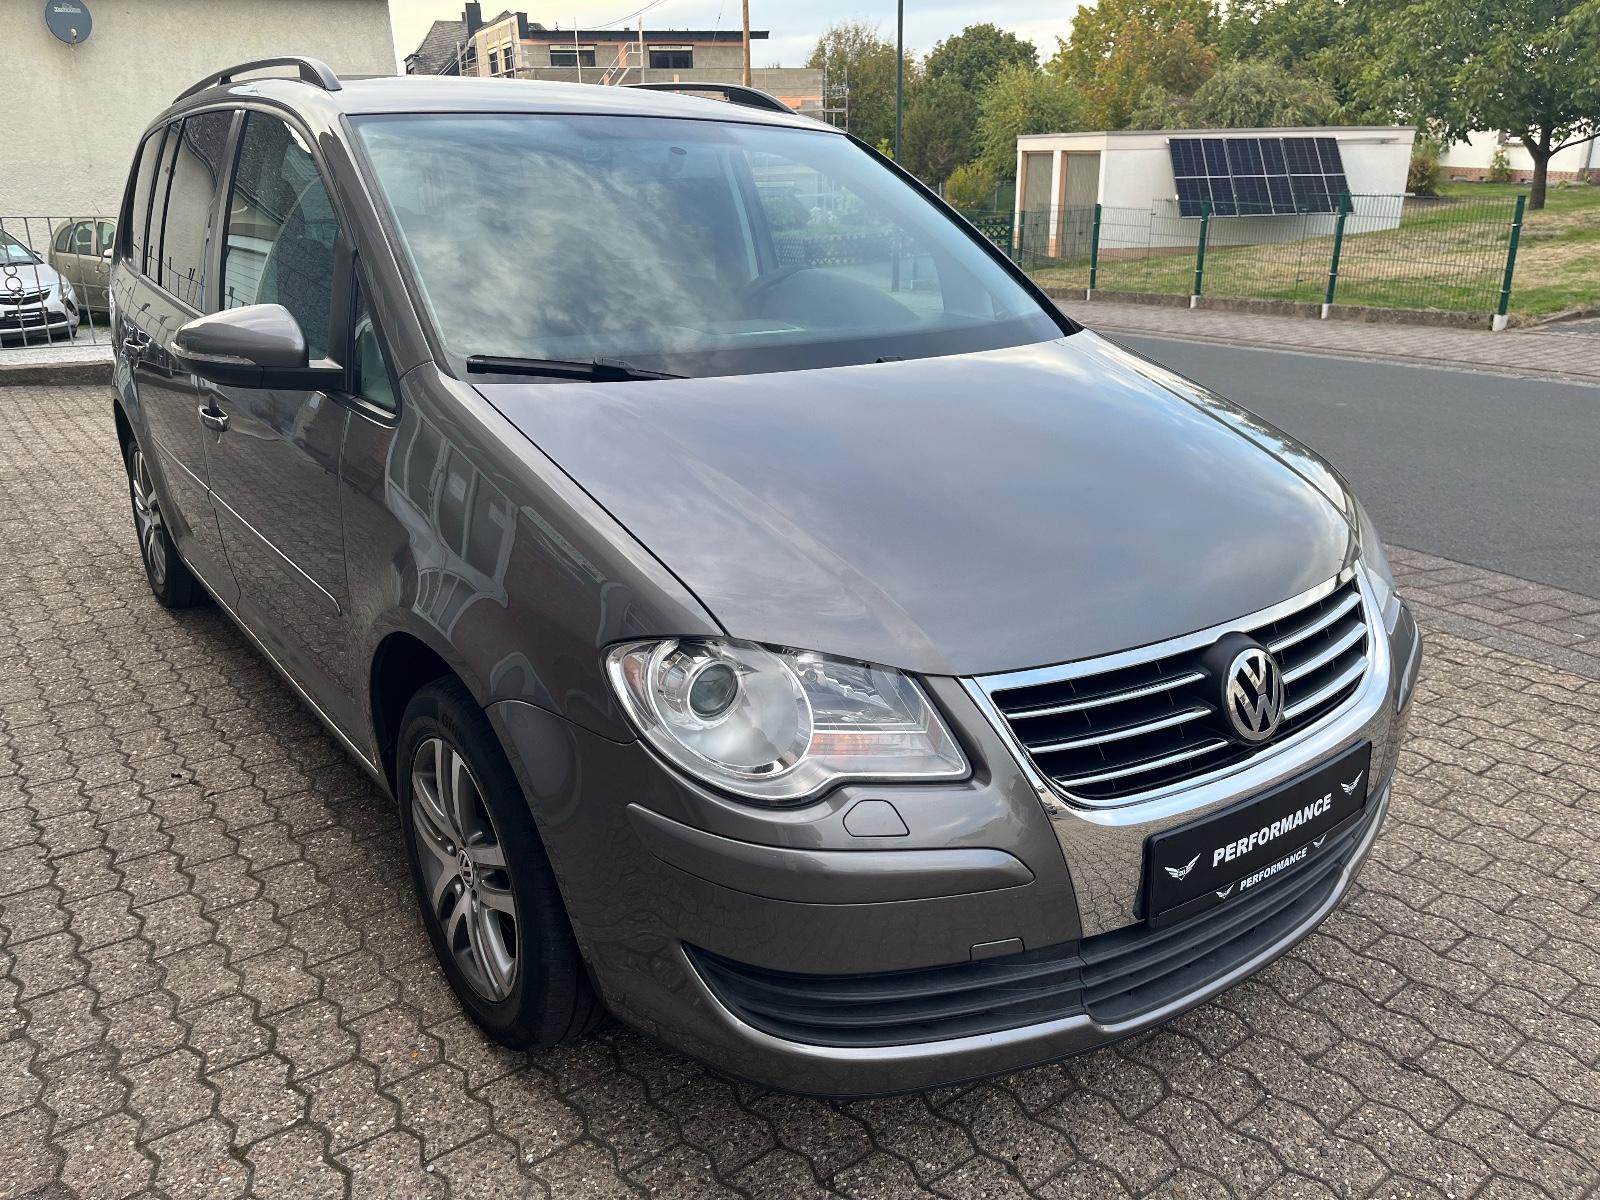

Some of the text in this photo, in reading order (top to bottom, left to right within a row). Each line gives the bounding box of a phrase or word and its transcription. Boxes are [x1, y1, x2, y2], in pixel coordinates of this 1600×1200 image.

[1228, 648, 1282, 741] VW
[1213, 793, 1332, 867] PERFORMANCE
[1240, 848, 1307, 891] PERFORMANCE
